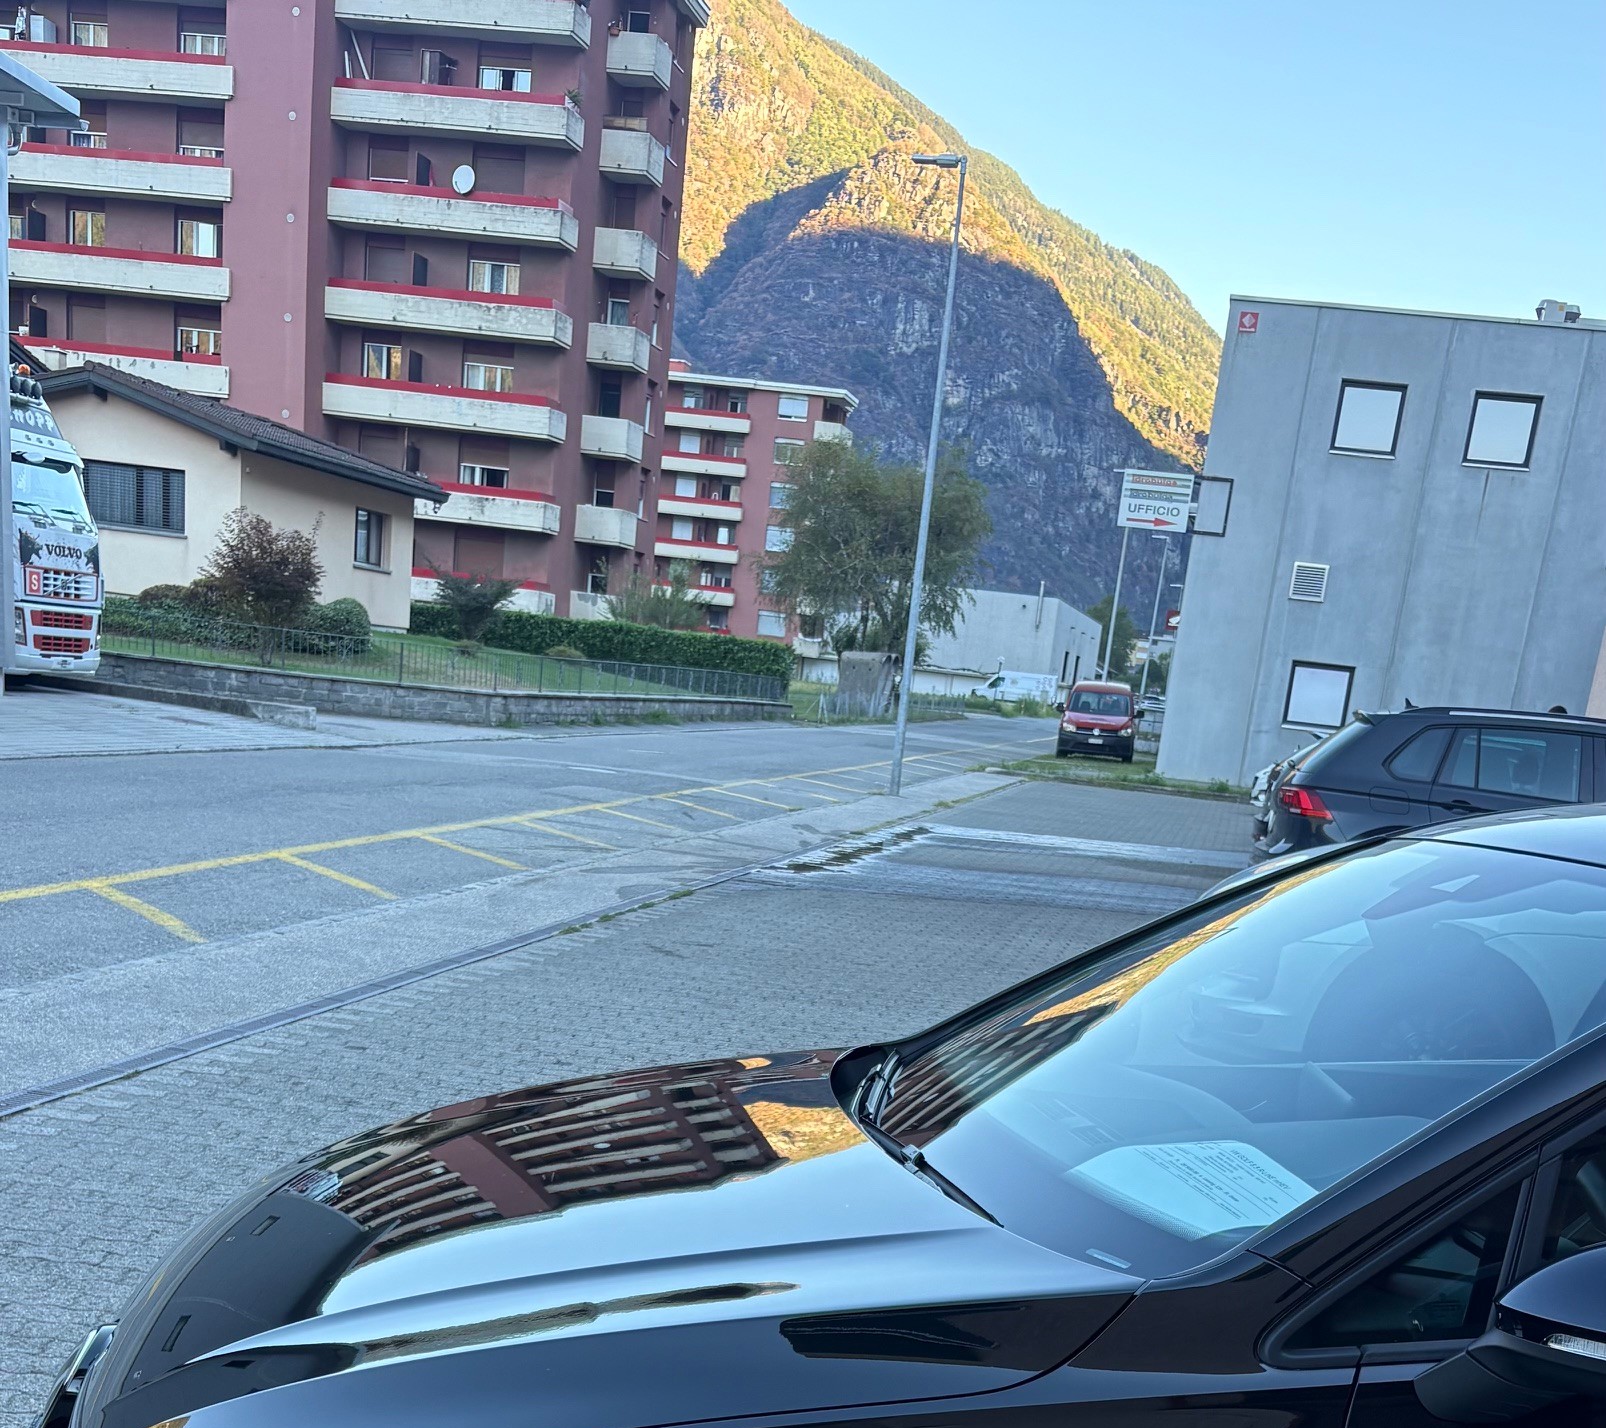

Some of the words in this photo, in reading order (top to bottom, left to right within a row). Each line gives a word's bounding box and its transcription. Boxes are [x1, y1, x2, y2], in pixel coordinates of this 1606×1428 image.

[1128, 503, 1180, 517] UFFICIO
[45, 543, 82, 559] VOLVO
[31, 574, 38, 591] S
